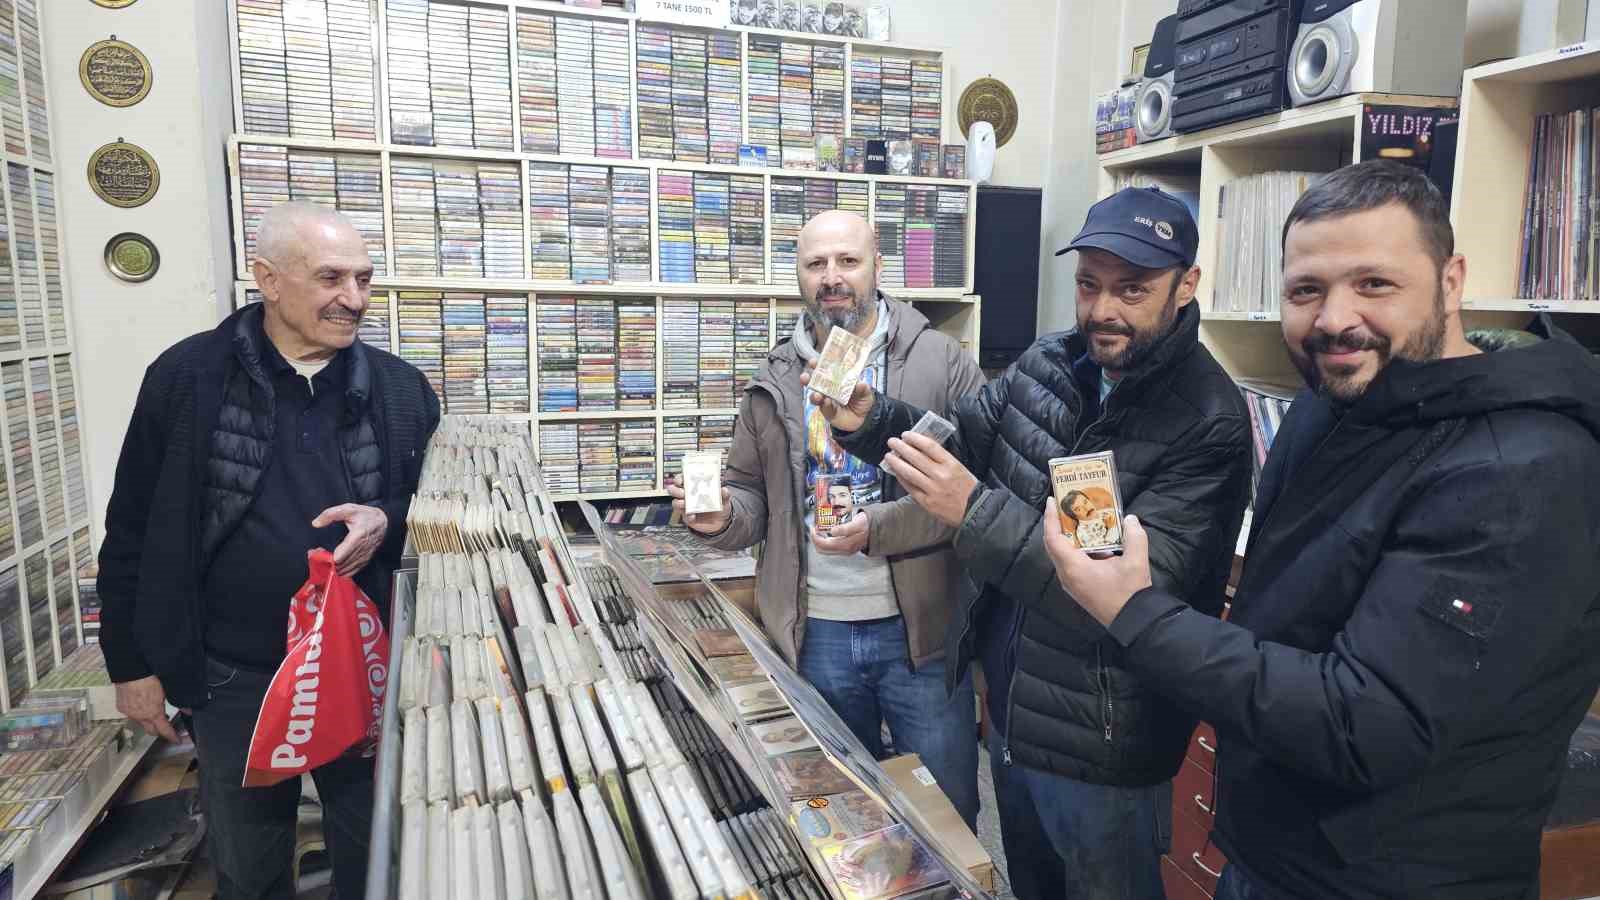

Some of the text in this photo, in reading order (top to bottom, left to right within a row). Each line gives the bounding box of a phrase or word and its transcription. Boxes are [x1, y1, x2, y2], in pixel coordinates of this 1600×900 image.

[663, 2, 681, 12] TANE
[685, 5, 702, 15] 1500
[704, 7, 712, 16] TL
[1369, 114, 1432, 136] YILDIZ
